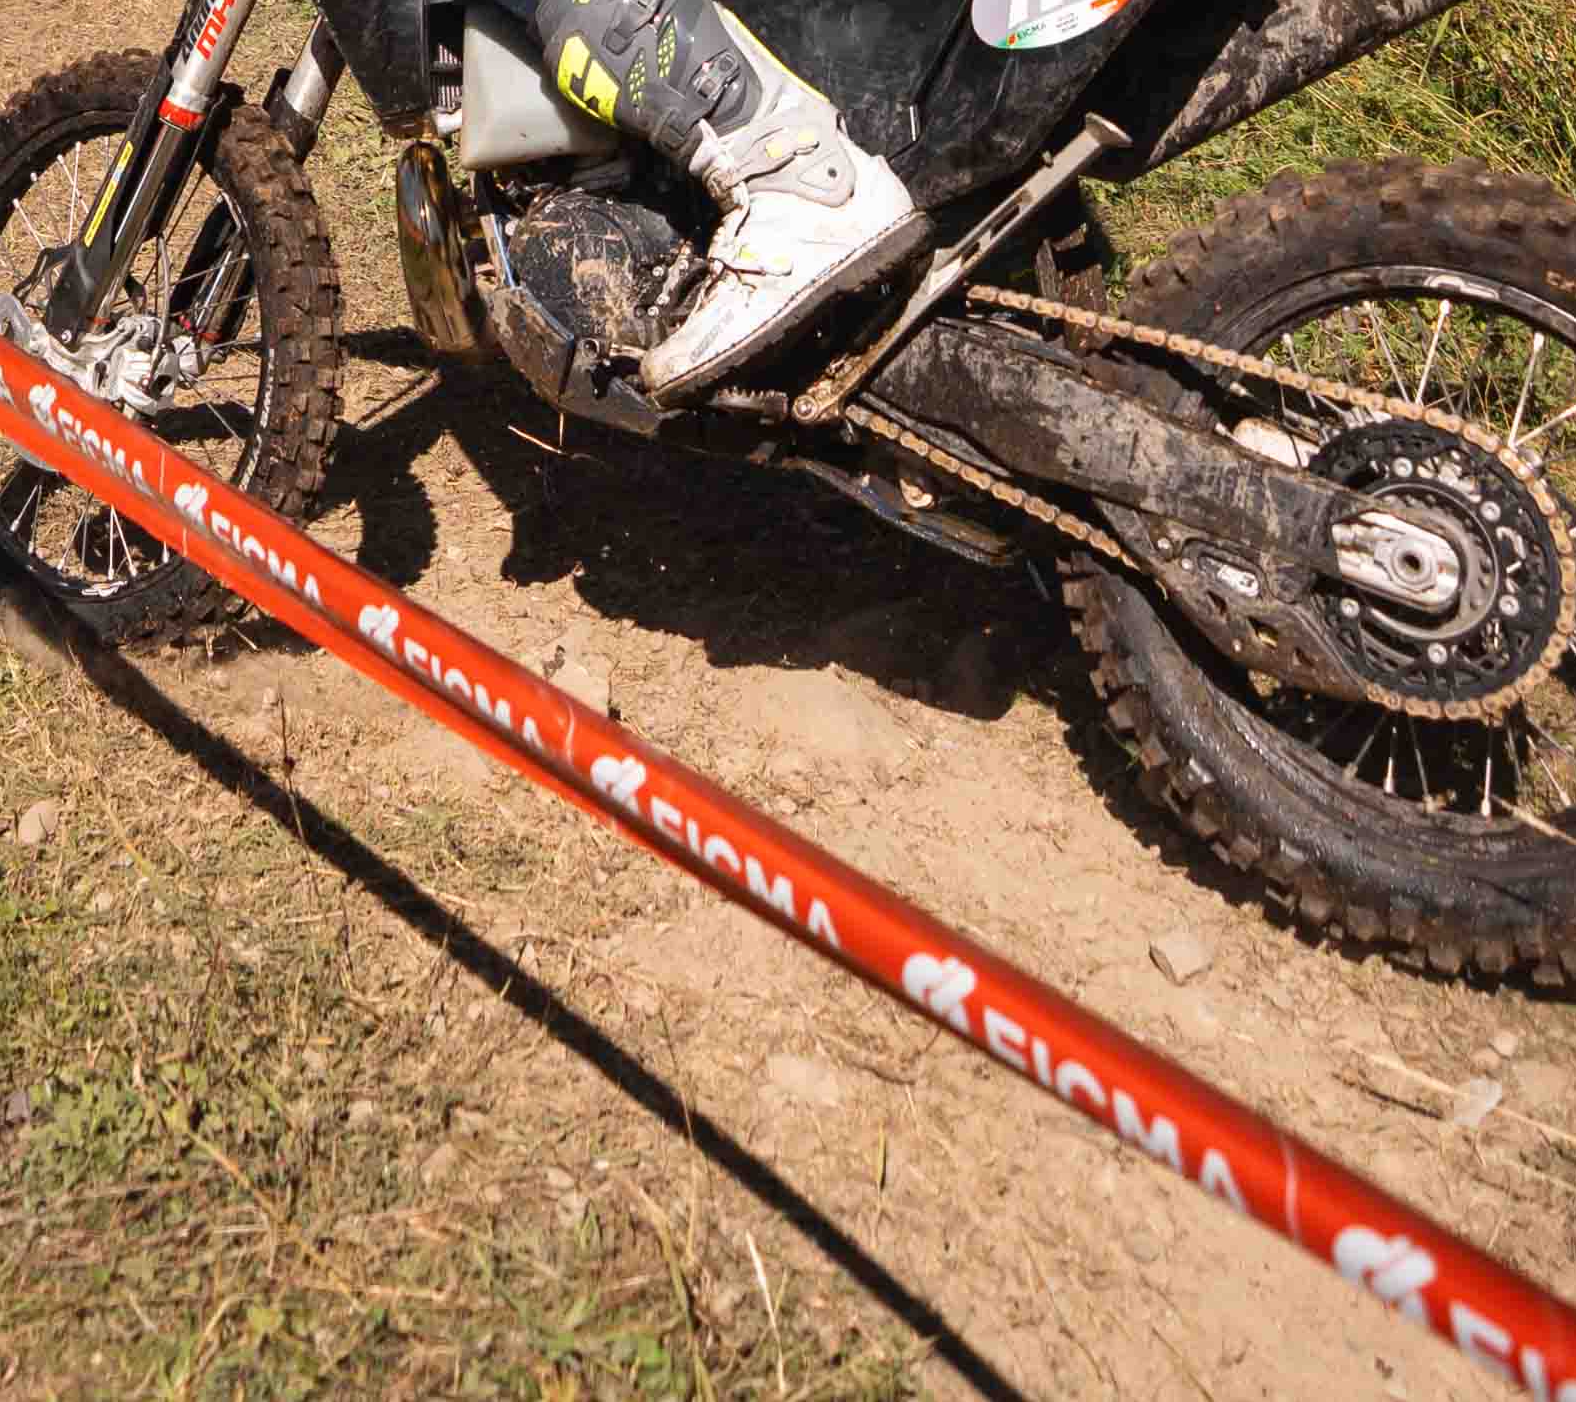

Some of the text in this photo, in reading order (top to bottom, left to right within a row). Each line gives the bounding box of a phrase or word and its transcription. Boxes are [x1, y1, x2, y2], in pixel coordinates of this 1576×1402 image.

[56, 405, 152, 497] EICMA
[647, 797, 841, 950] EICMA
[982, 1005, 1248, 1217] EICMA
